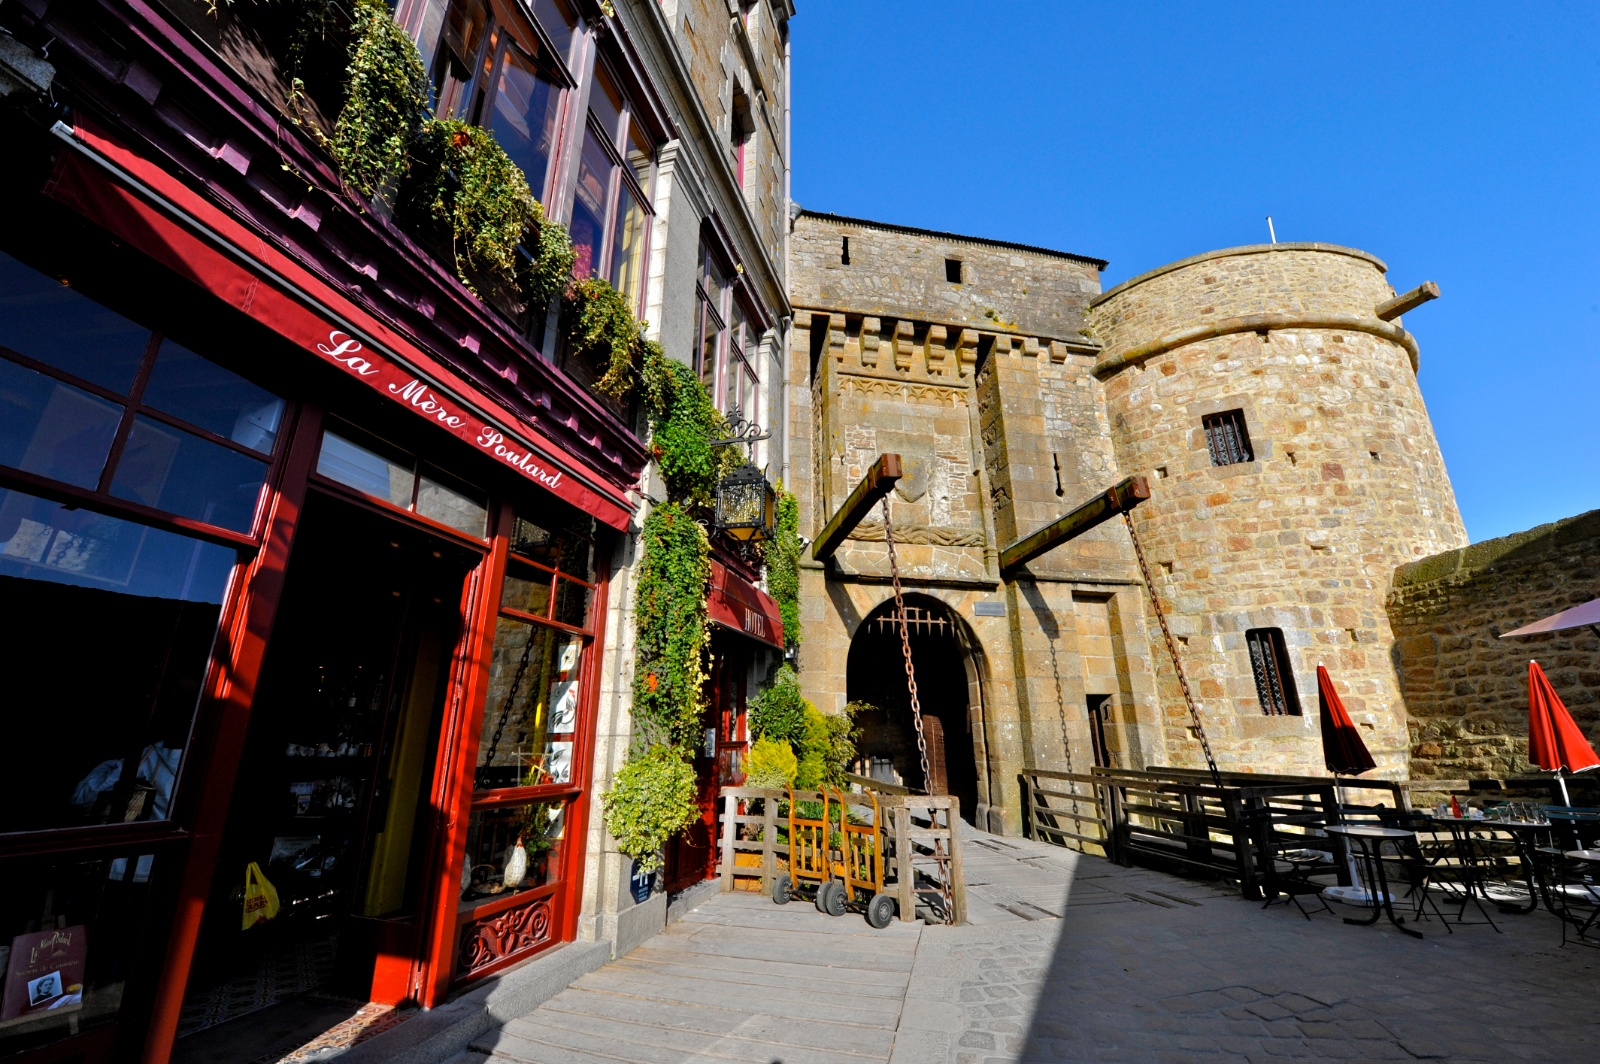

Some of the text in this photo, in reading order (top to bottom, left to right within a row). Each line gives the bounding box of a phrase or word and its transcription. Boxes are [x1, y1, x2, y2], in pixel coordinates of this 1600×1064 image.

[317, 330, 562, 489] La Mère Poulard
[744, 607, 766, 638] HOTEL
